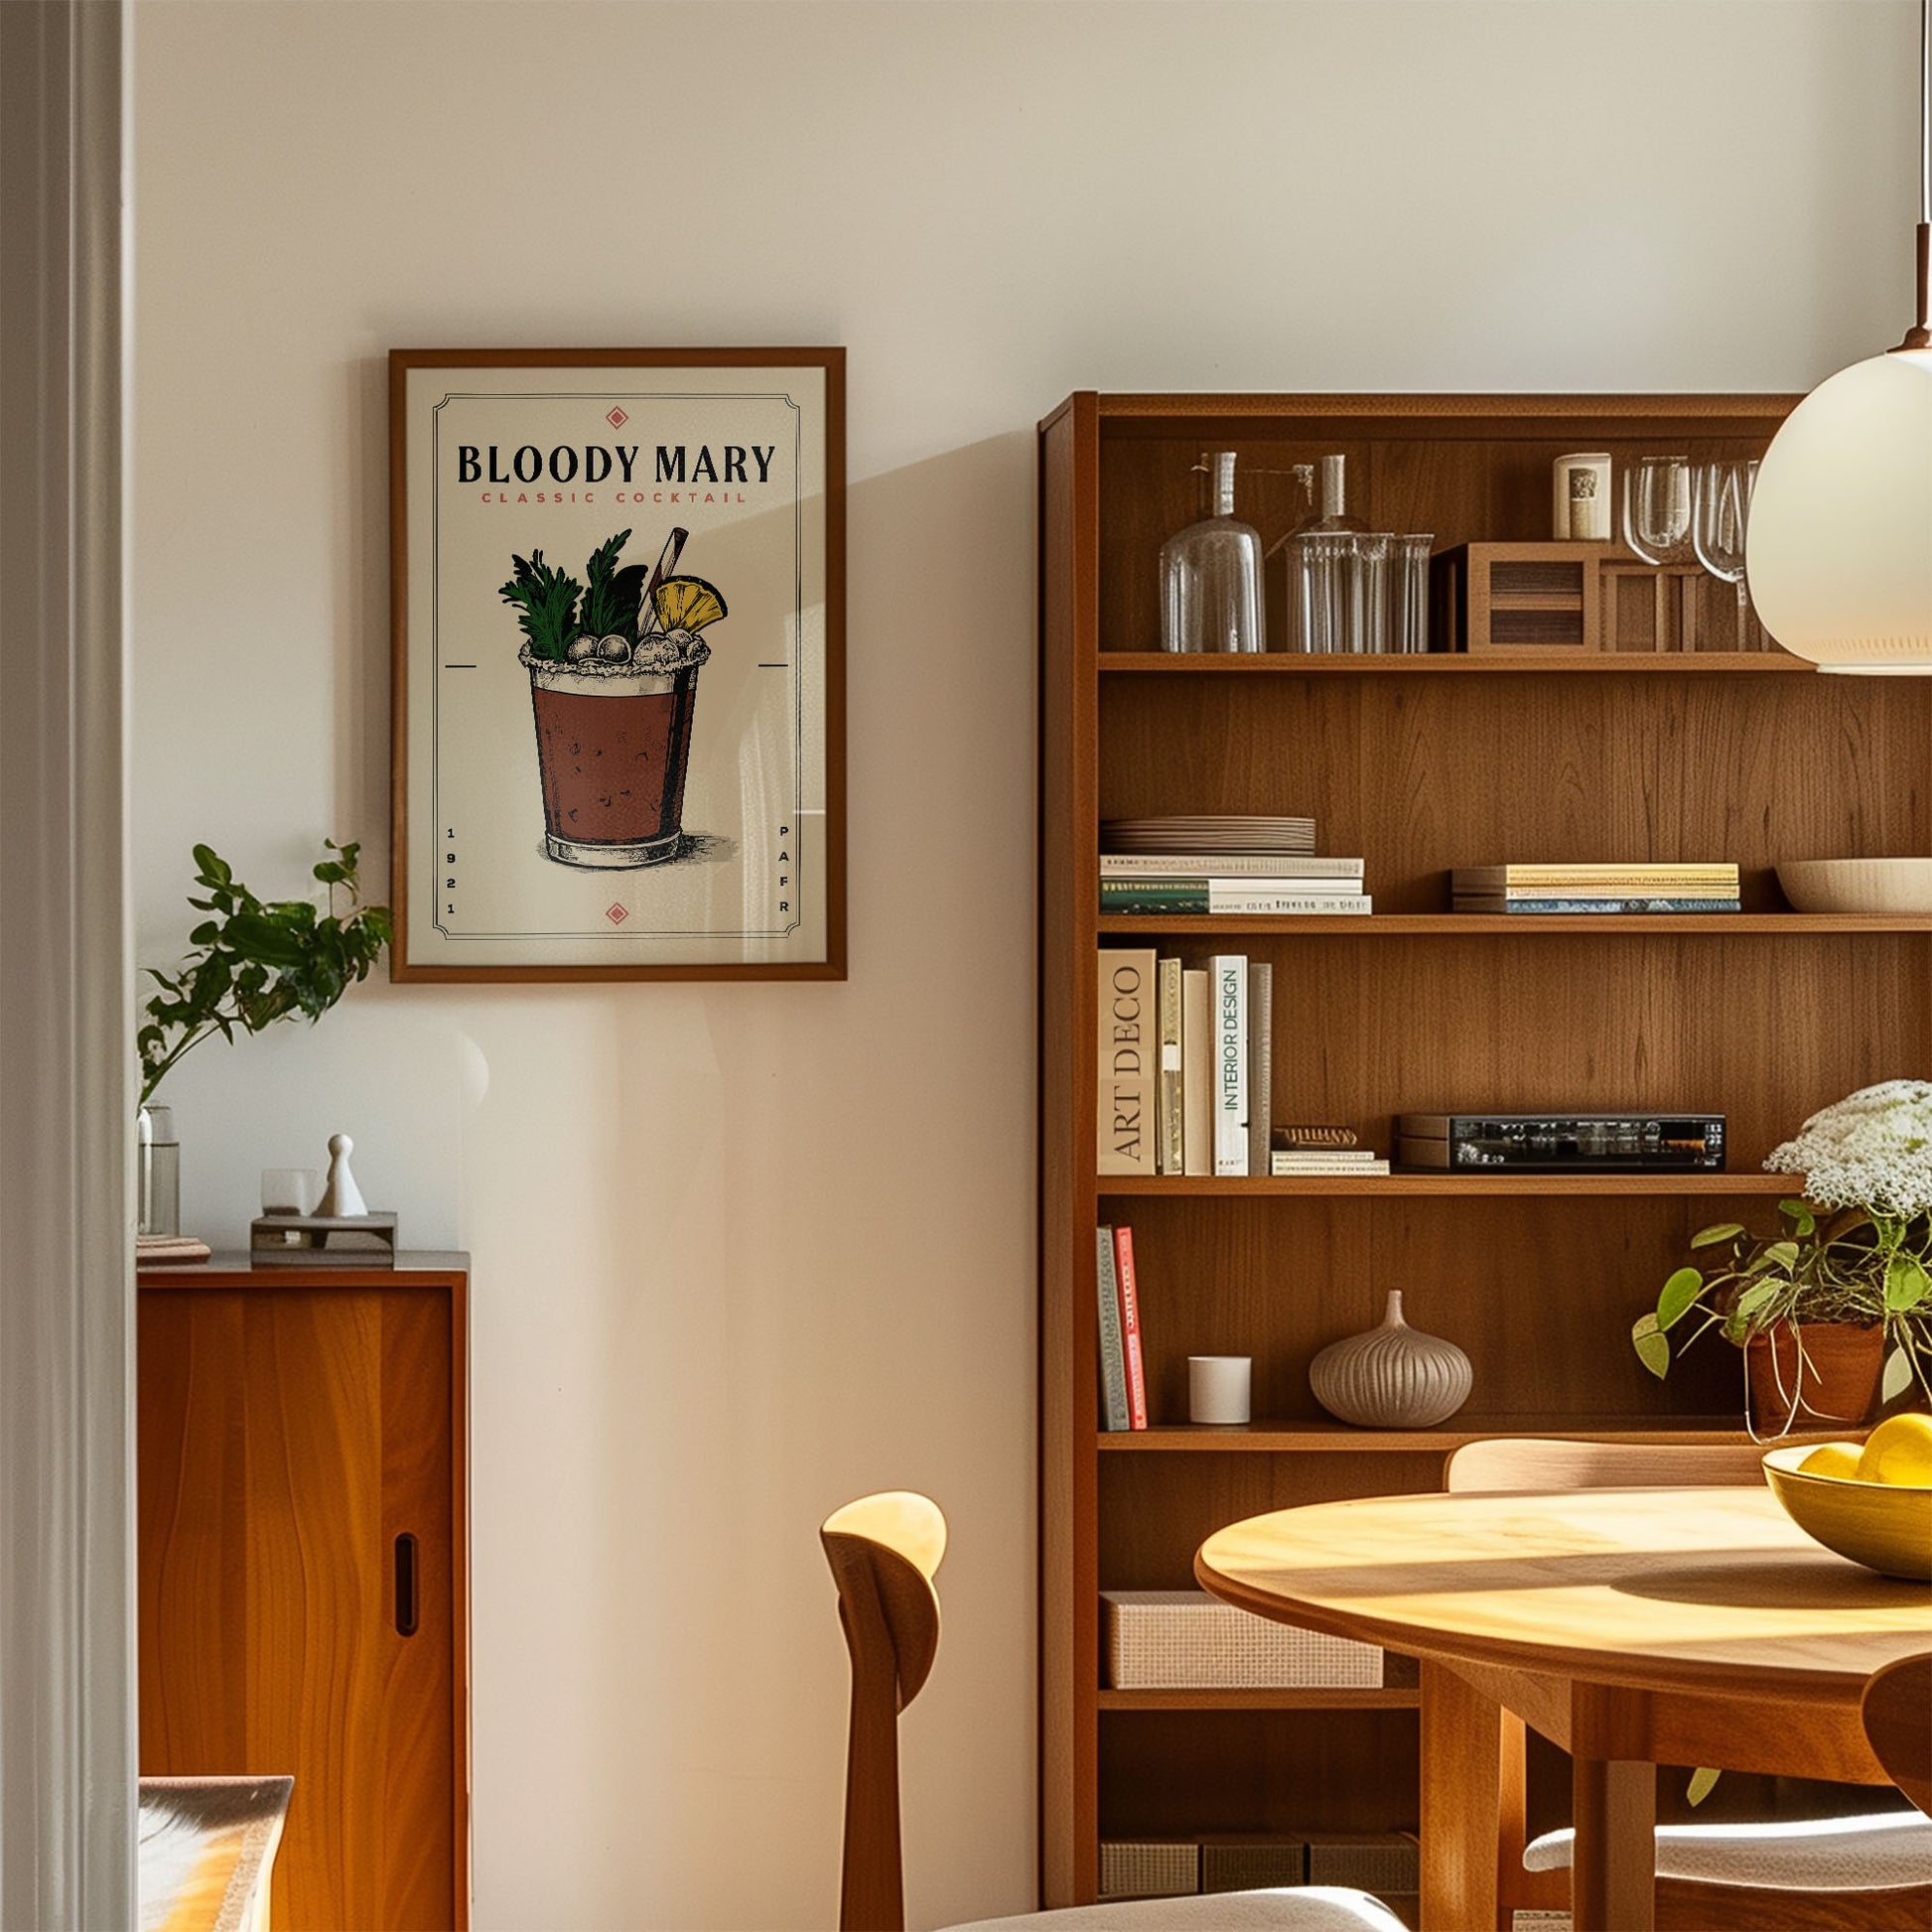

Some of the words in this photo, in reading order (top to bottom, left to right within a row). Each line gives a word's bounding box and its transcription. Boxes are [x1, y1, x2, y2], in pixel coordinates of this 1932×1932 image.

[458, 445, 639, 483] BLOODY
[655, 445, 775, 483] MARY
[482, 492, 596, 504] CLASSIC
[616, 492, 746, 504] COCKTAIL
[1112, 965, 1141, 1077] DECO
[1222, 969, 1238, 1031] DESIGN
[1223, 1035, 1238, 1111] INTERIOR
[1112, 1085, 1141, 1162] ART
